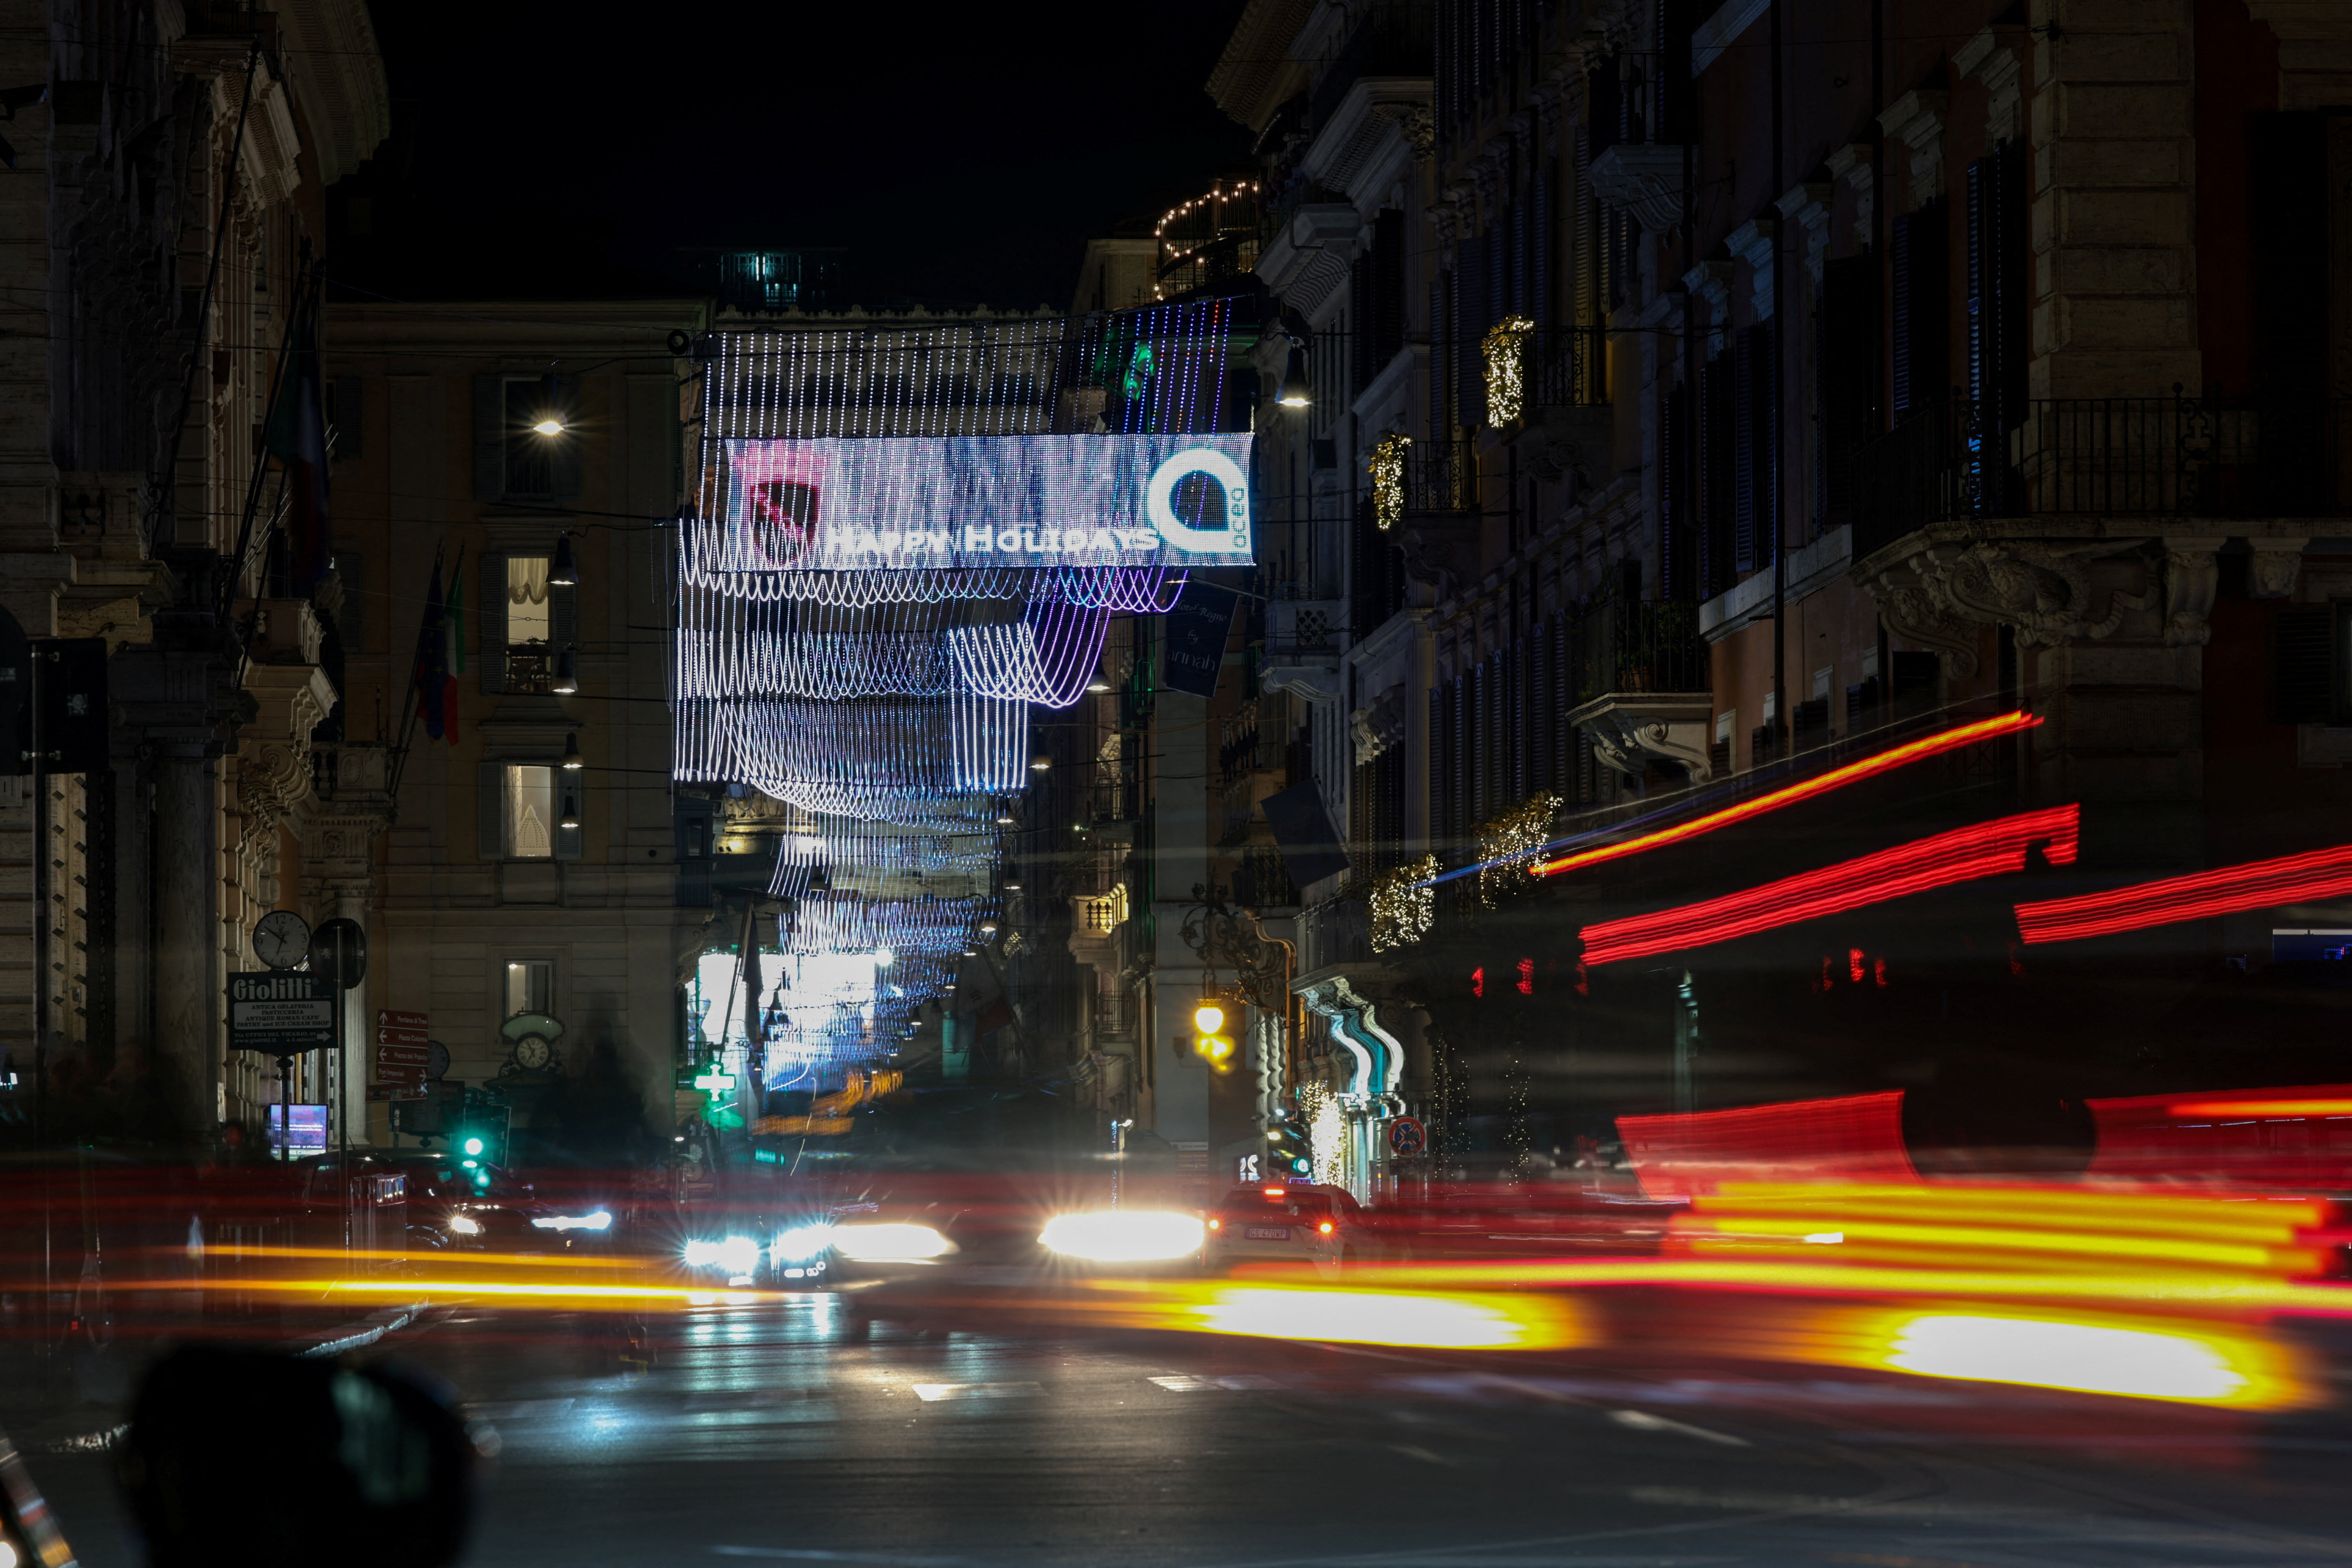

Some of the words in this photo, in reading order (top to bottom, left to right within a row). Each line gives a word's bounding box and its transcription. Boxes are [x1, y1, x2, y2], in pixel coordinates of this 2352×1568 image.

[1231, 487, 1247, 548] acea
[1174, 599, 1200, 612] Hotel
[1199, 608, 1227, 622] Regno
[1188, 630, 1199, 644] by
[234, 978, 311, 1000] Giolitti
